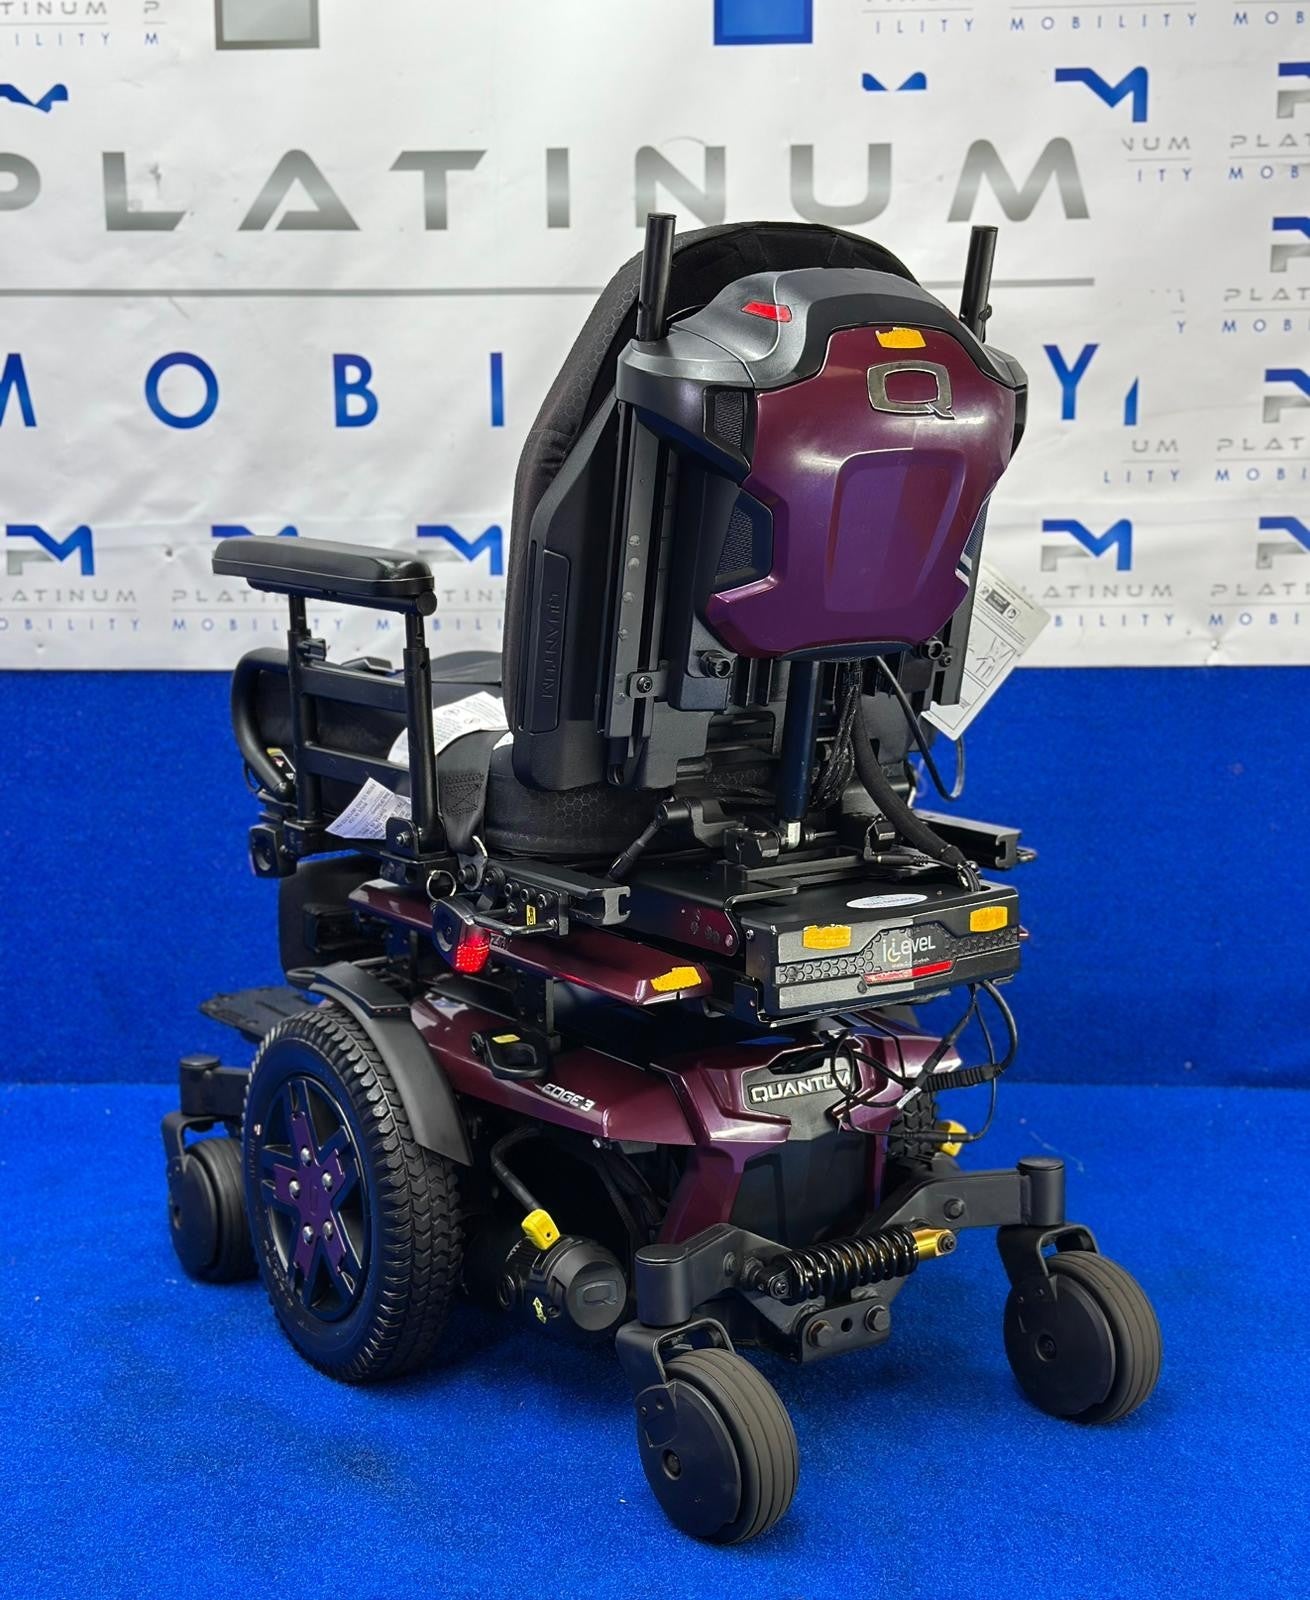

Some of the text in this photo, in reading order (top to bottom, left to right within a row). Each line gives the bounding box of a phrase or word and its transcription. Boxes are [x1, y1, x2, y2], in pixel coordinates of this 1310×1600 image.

[1010, 13, 1197, 31] MOBILITY
[1228, 164, 1299, 181] MOB
[867, 360, 955, 420] Q
[0, 588, 137, 603] ATINUM
[172, 618, 342, 631] MOBILTY
